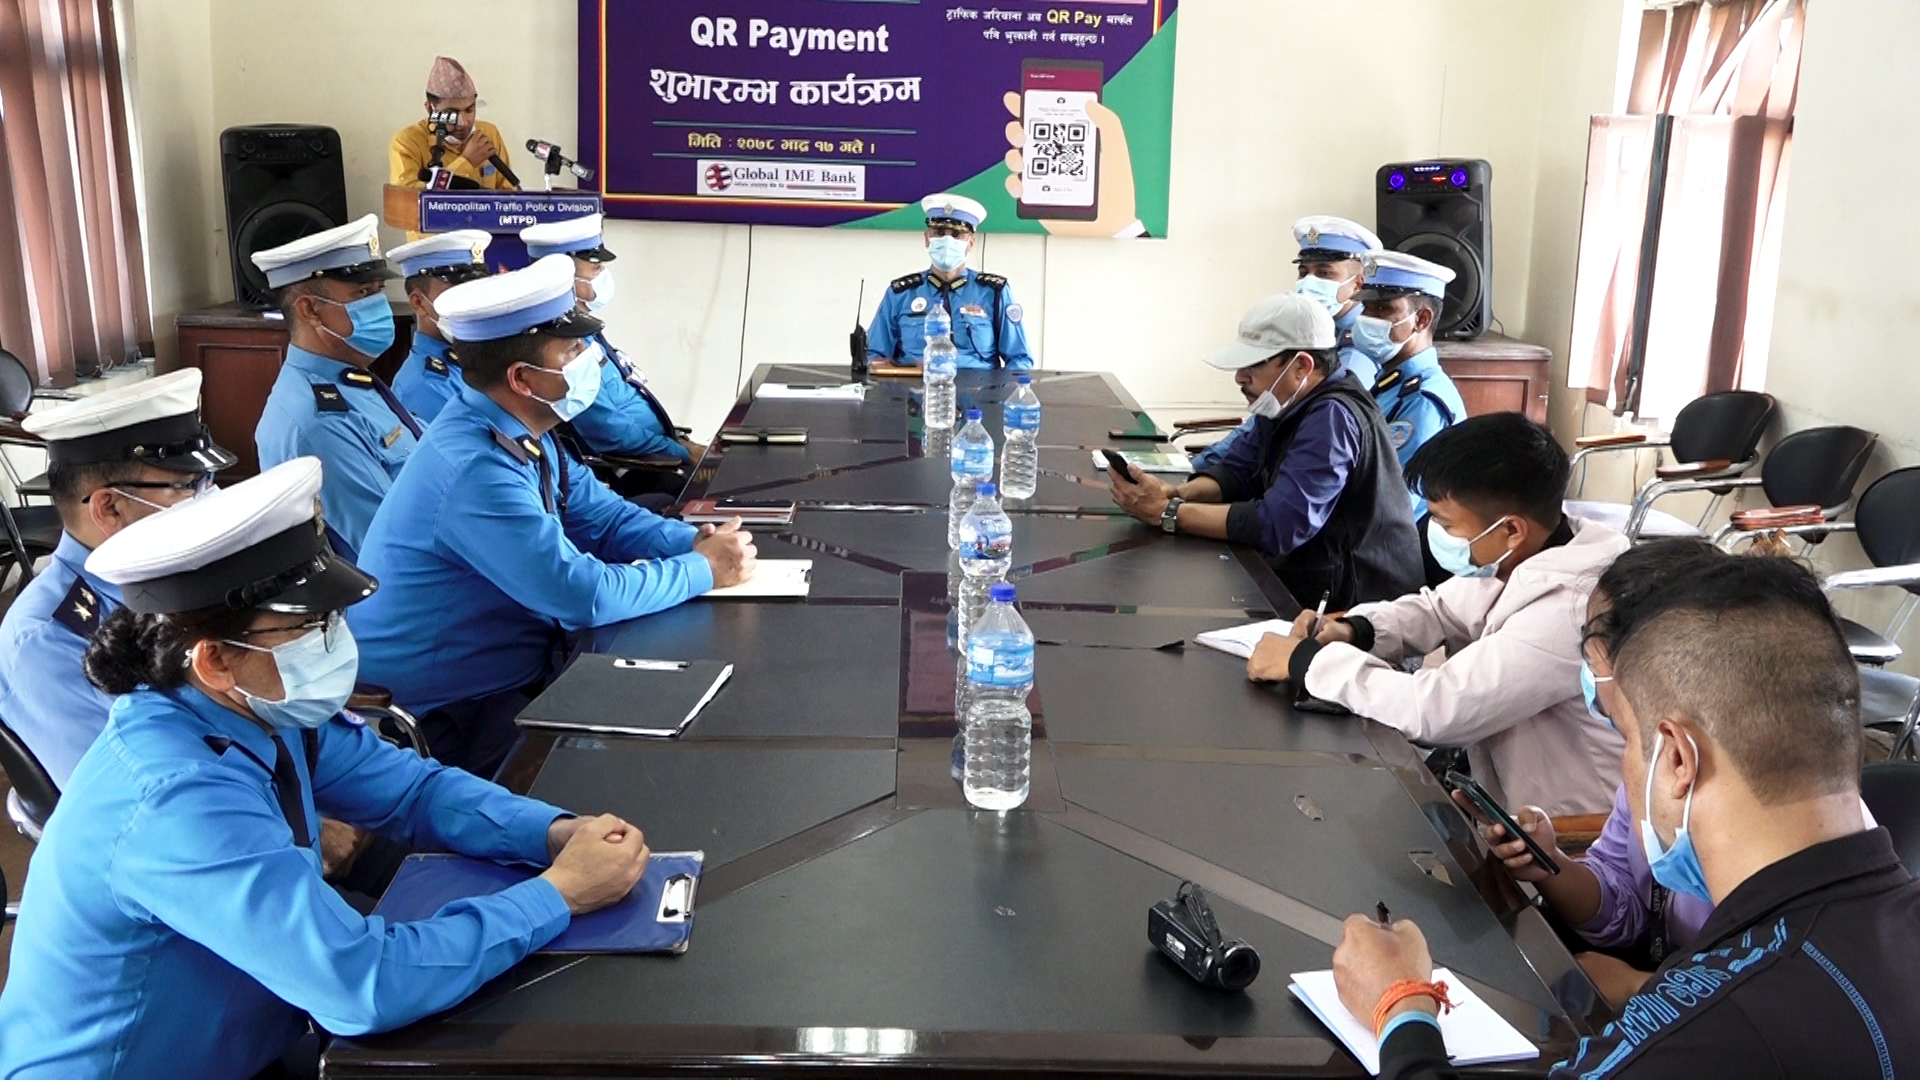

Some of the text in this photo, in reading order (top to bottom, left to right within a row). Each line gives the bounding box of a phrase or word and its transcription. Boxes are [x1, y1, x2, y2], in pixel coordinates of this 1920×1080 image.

[1047, 10, 1069, 23] QR
[1075, 11, 1101, 27] Pay
[691, 17, 889, 56] QR Payment
[983, 28, 1000, 39] पनि
[650, 69, 921, 105] शुभारम्भ कार्यक्रम
[688, 133, 722, 148] मिति
[781, 140, 810, 152] भाद्र
[815, 141, 833, 152] १७
[839, 139, 863, 153] गते
[734, 168, 855, 183] Global IME Bank
[428, 201, 594, 213] Metropolitan Traffic Police Division
[498, 215, 537, 227] (MTPD)
